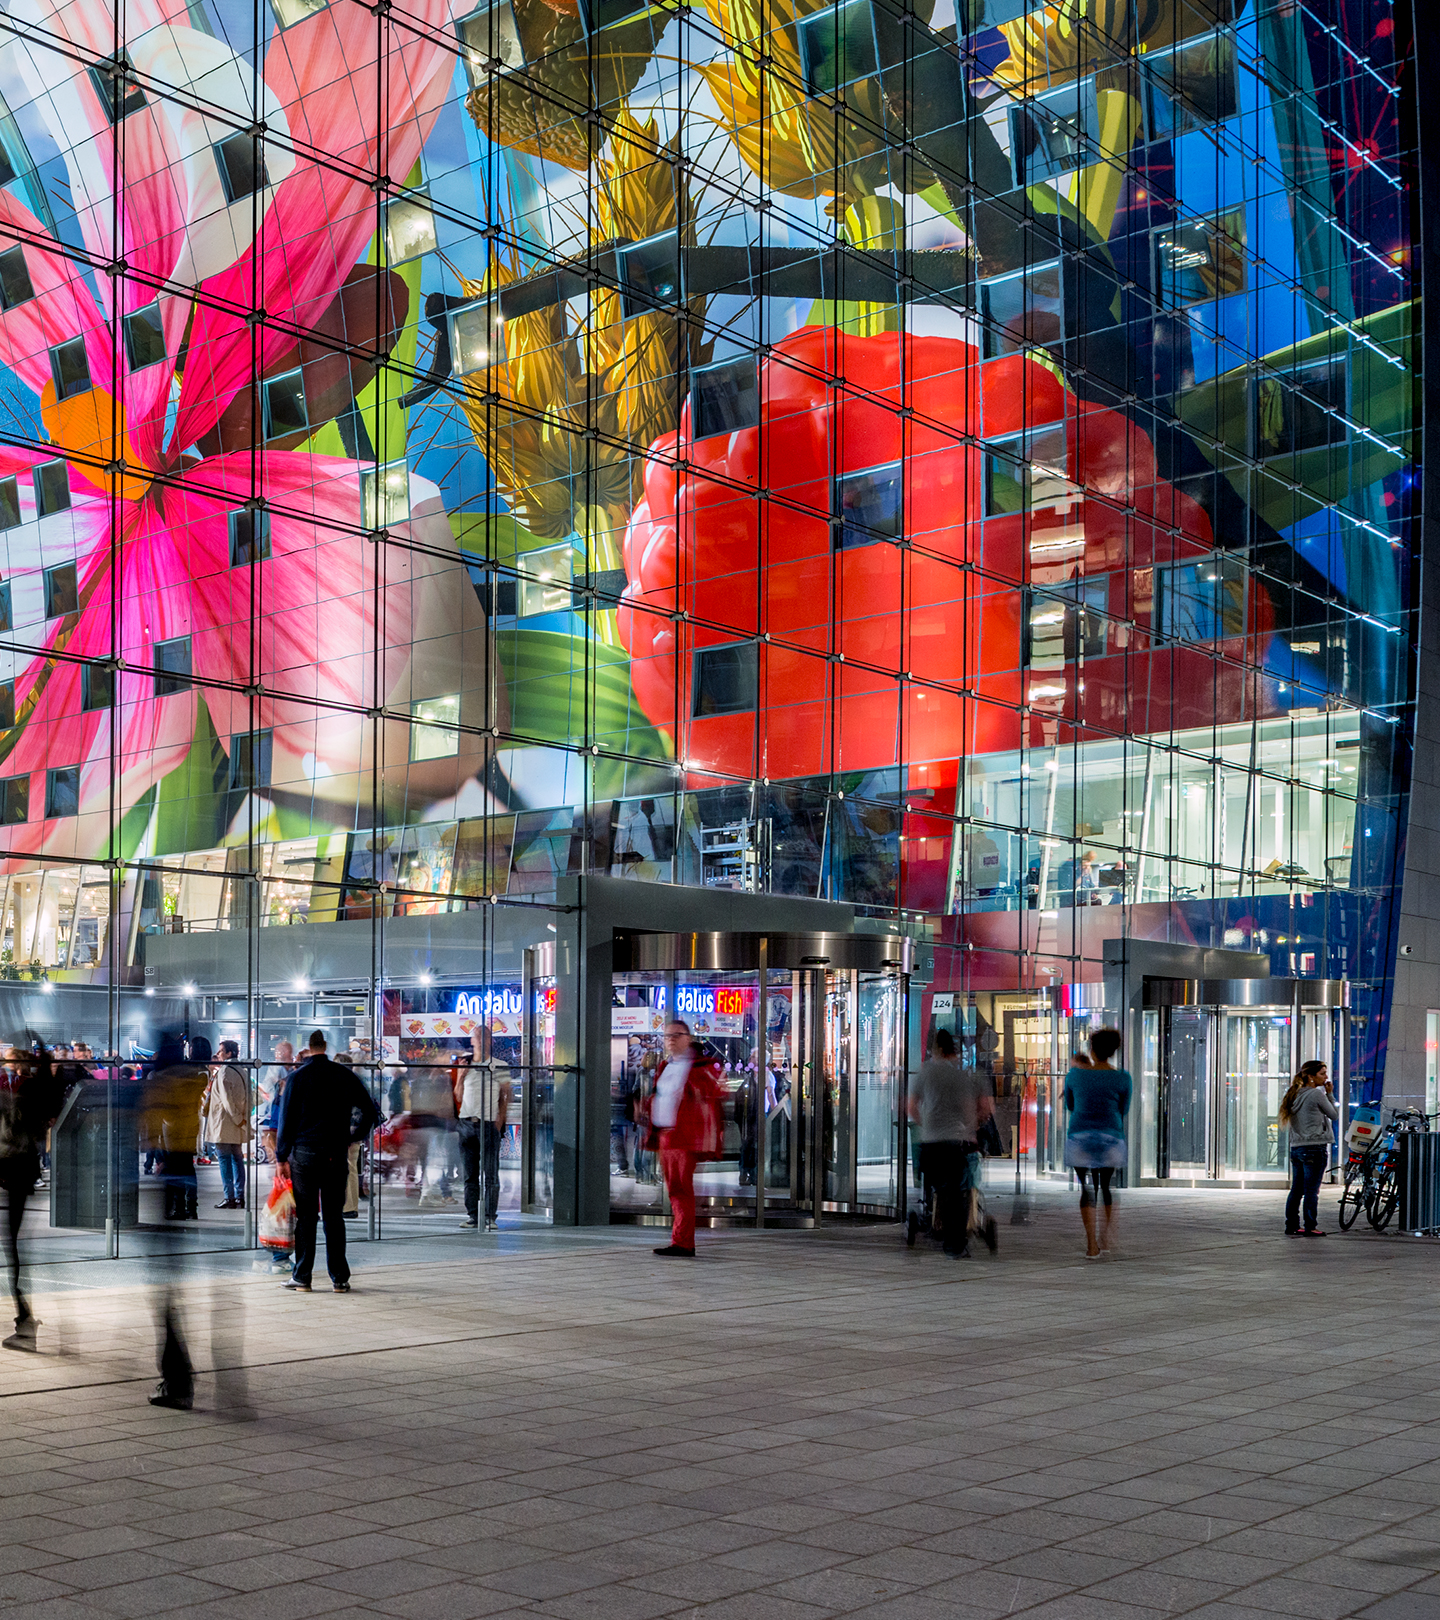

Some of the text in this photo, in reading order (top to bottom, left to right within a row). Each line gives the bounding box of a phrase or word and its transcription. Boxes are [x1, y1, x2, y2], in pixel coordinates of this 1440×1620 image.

[657, 987, 743, 1015] Adalus Fish
[934, 1000, 951, 1008] 124
